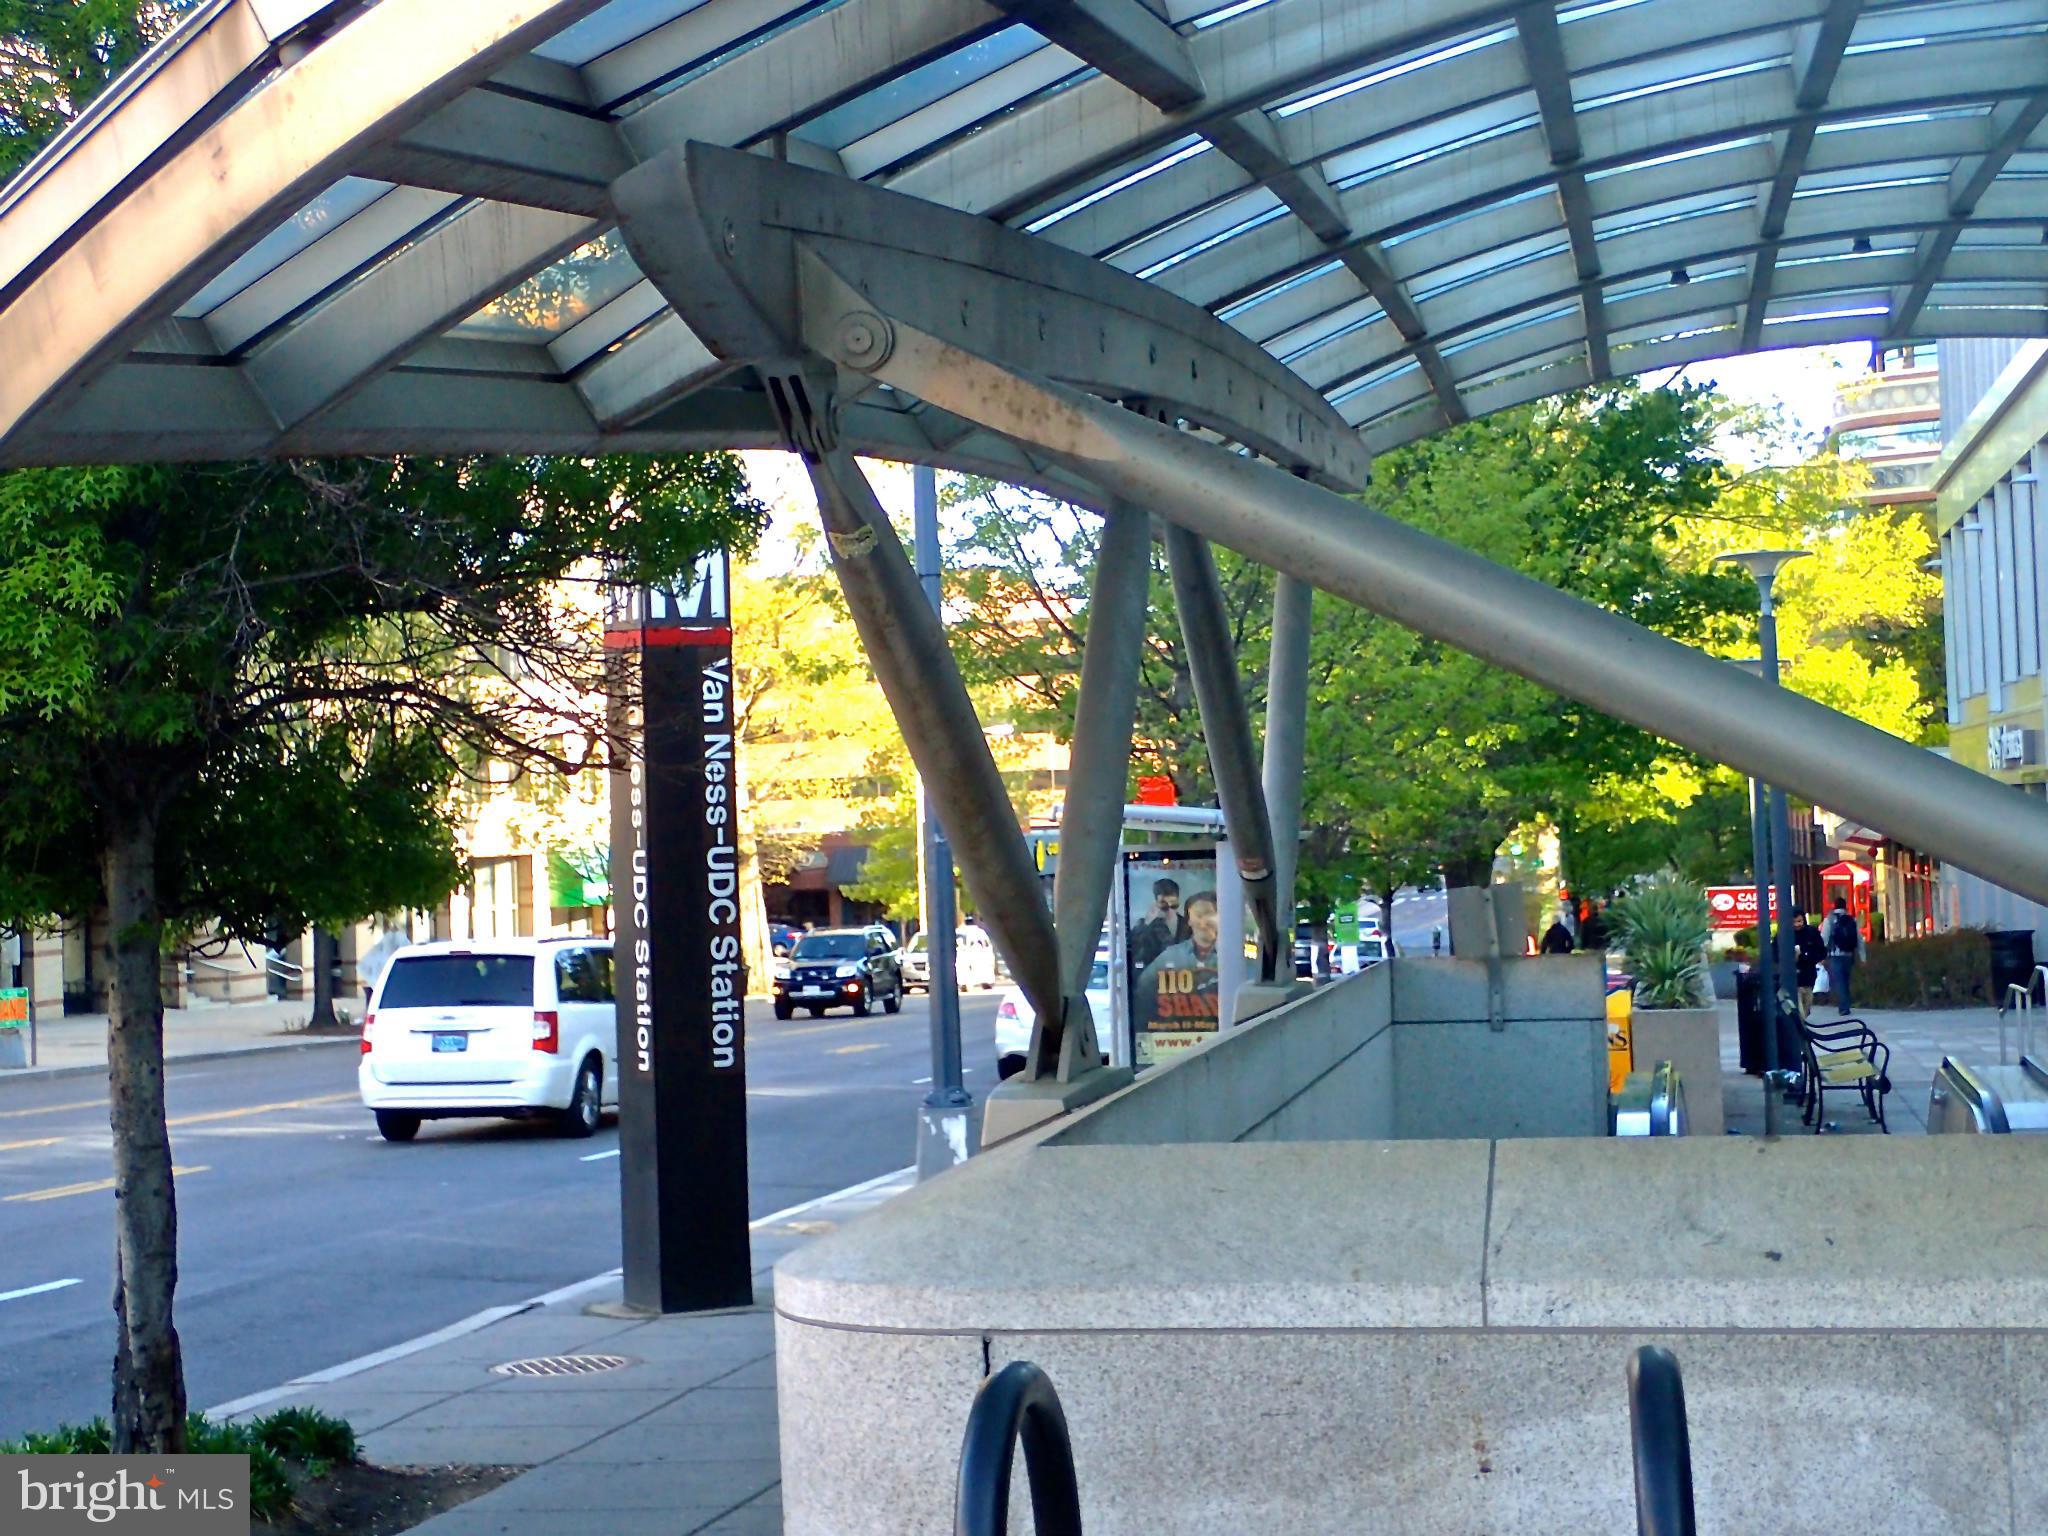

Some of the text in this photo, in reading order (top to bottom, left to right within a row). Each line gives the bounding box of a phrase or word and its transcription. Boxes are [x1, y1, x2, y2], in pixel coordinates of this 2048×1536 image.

[702, 656, 740, 1069] Van Ness-UDC Station
[634, 939, 652, 1072] Station
[1158, 969, 1193, 993] 110
